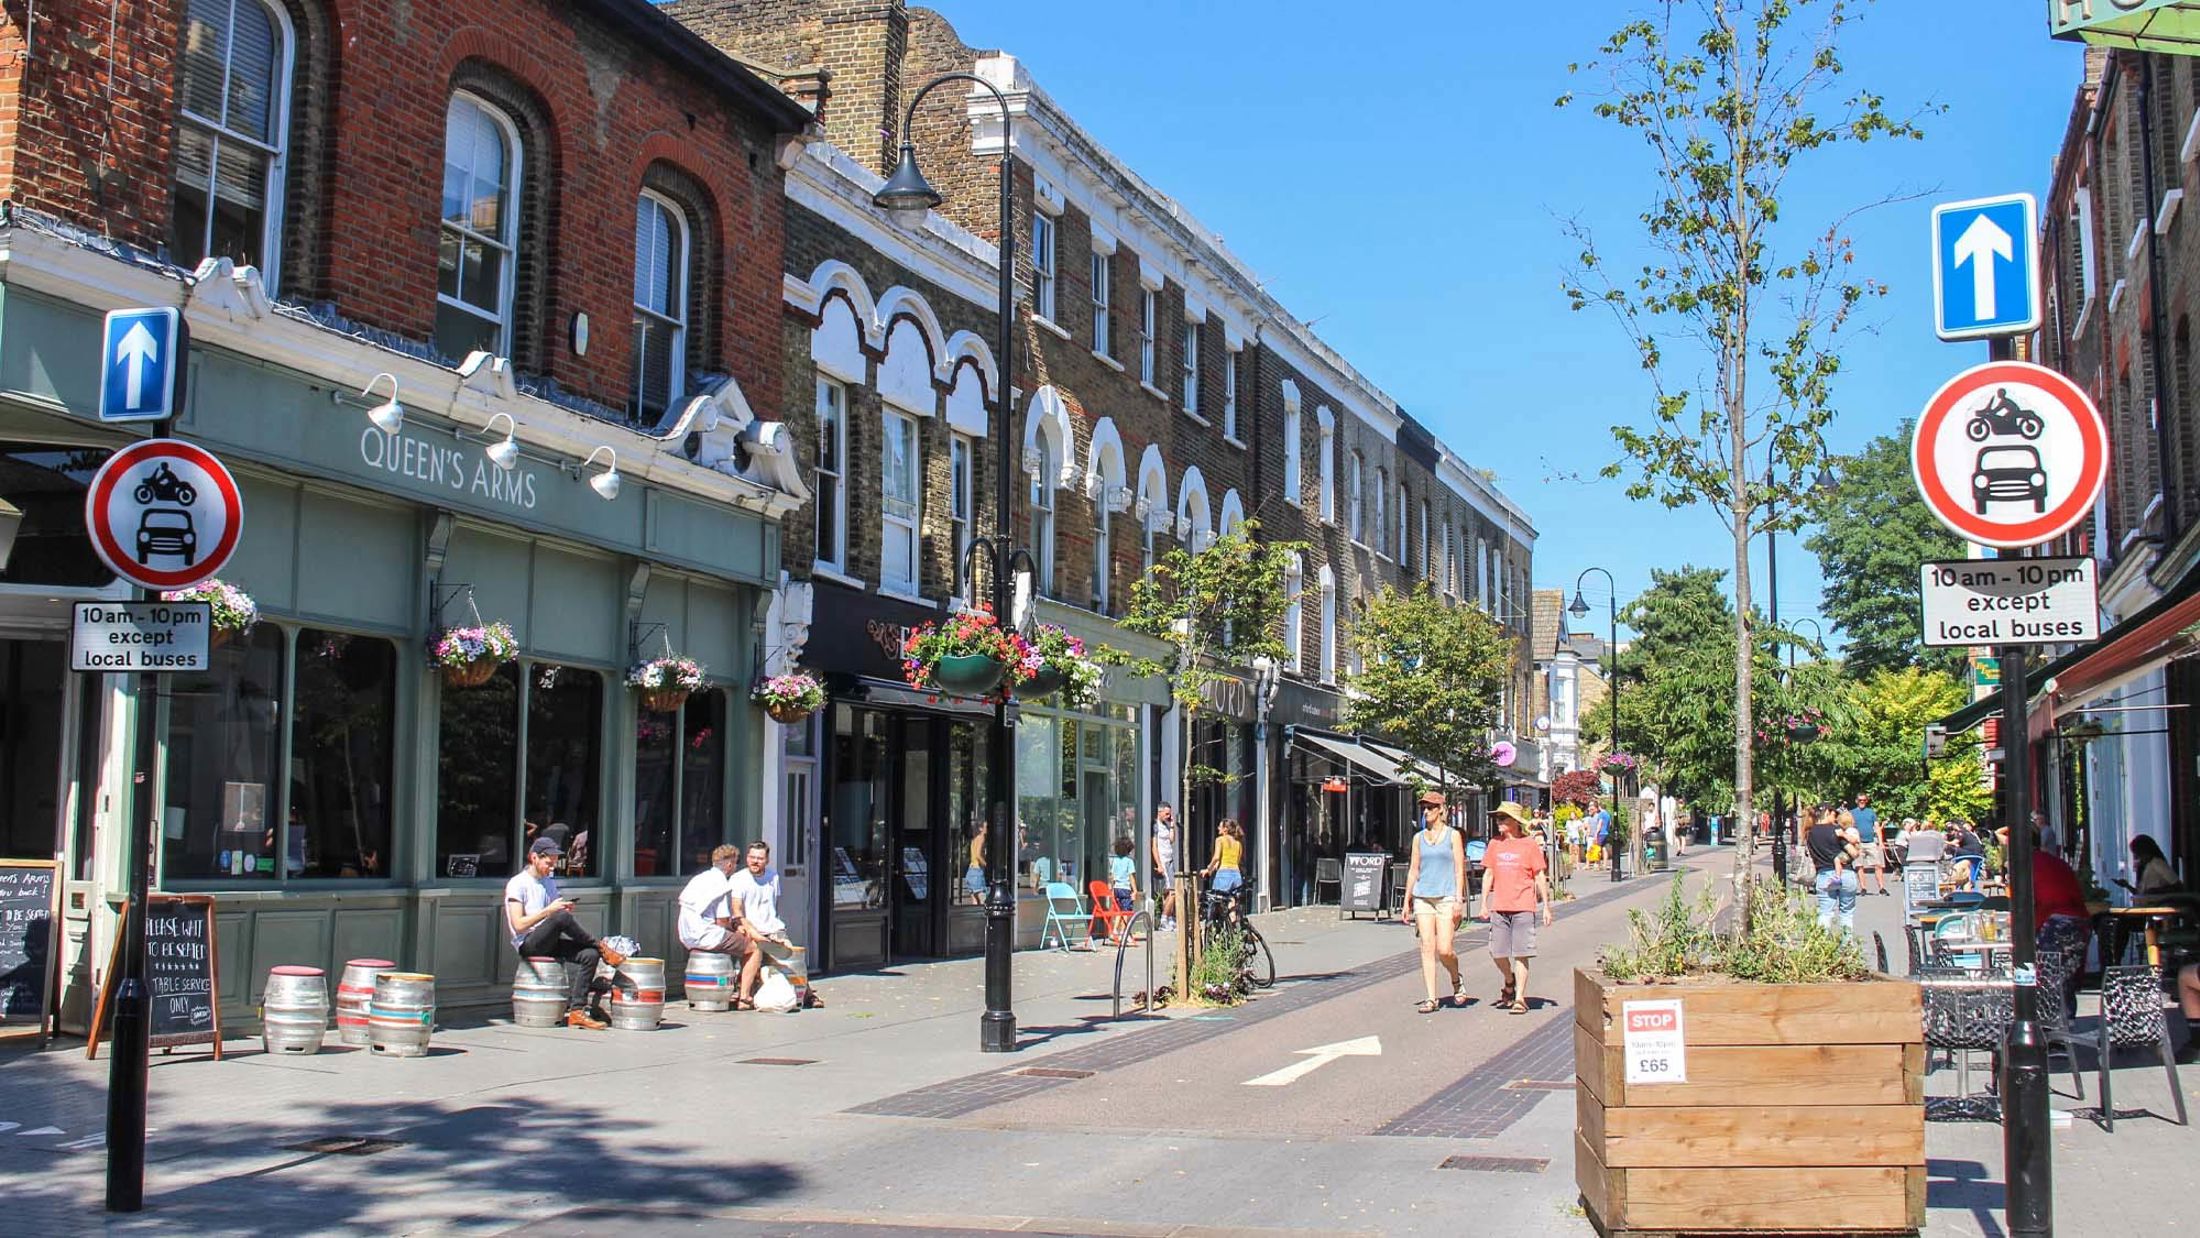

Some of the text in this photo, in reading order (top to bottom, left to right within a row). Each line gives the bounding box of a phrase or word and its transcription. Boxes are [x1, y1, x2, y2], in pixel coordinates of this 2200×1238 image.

[360, 427, 536, 509] QUEEN'S ARMS
[1967, 591, 2050, 613] except
[1940, 618, 2083, 640] local buses
[109, 629, 174, 647] except
[85, 651, 197, 666] local buses
[1349, 856, 1382, 866] WORD
[148, 942, 159, 957] TO
[162, 942, 175, 957] BE
[152, 977, 211, 993] TABLE SERVICE
[169, 997, 189, 1013] ONLY
[1632, 1013, 1673, 1028] STOP
[1640, 1059, 1669, 1073] £65
